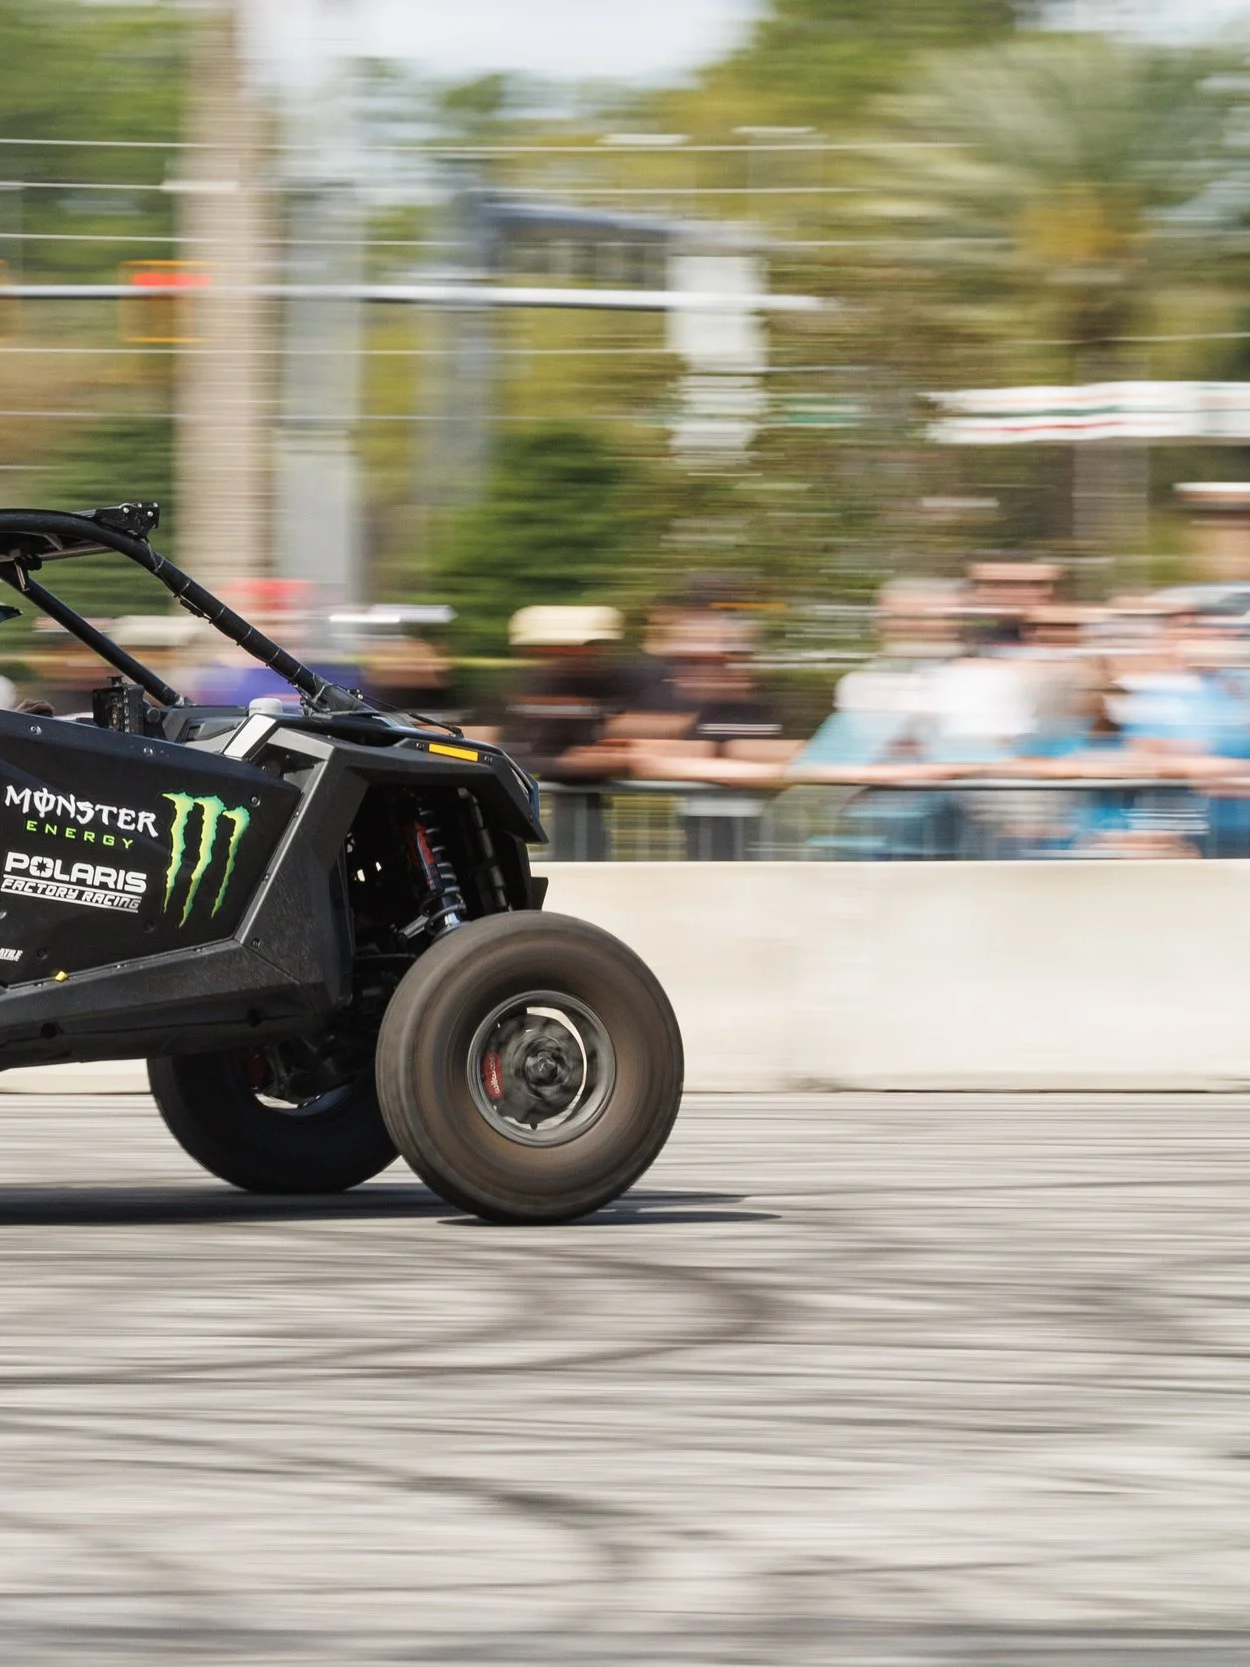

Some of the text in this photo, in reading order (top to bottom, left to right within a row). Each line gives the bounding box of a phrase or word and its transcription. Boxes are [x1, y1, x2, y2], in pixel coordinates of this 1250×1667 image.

[5, 785, 158, 838] MONSTER
[26, 820, 134, 849] ENERGY
[4, 851, 147, 893] POLARIS
[1, 878, 141, 909] FACTORY RACING
